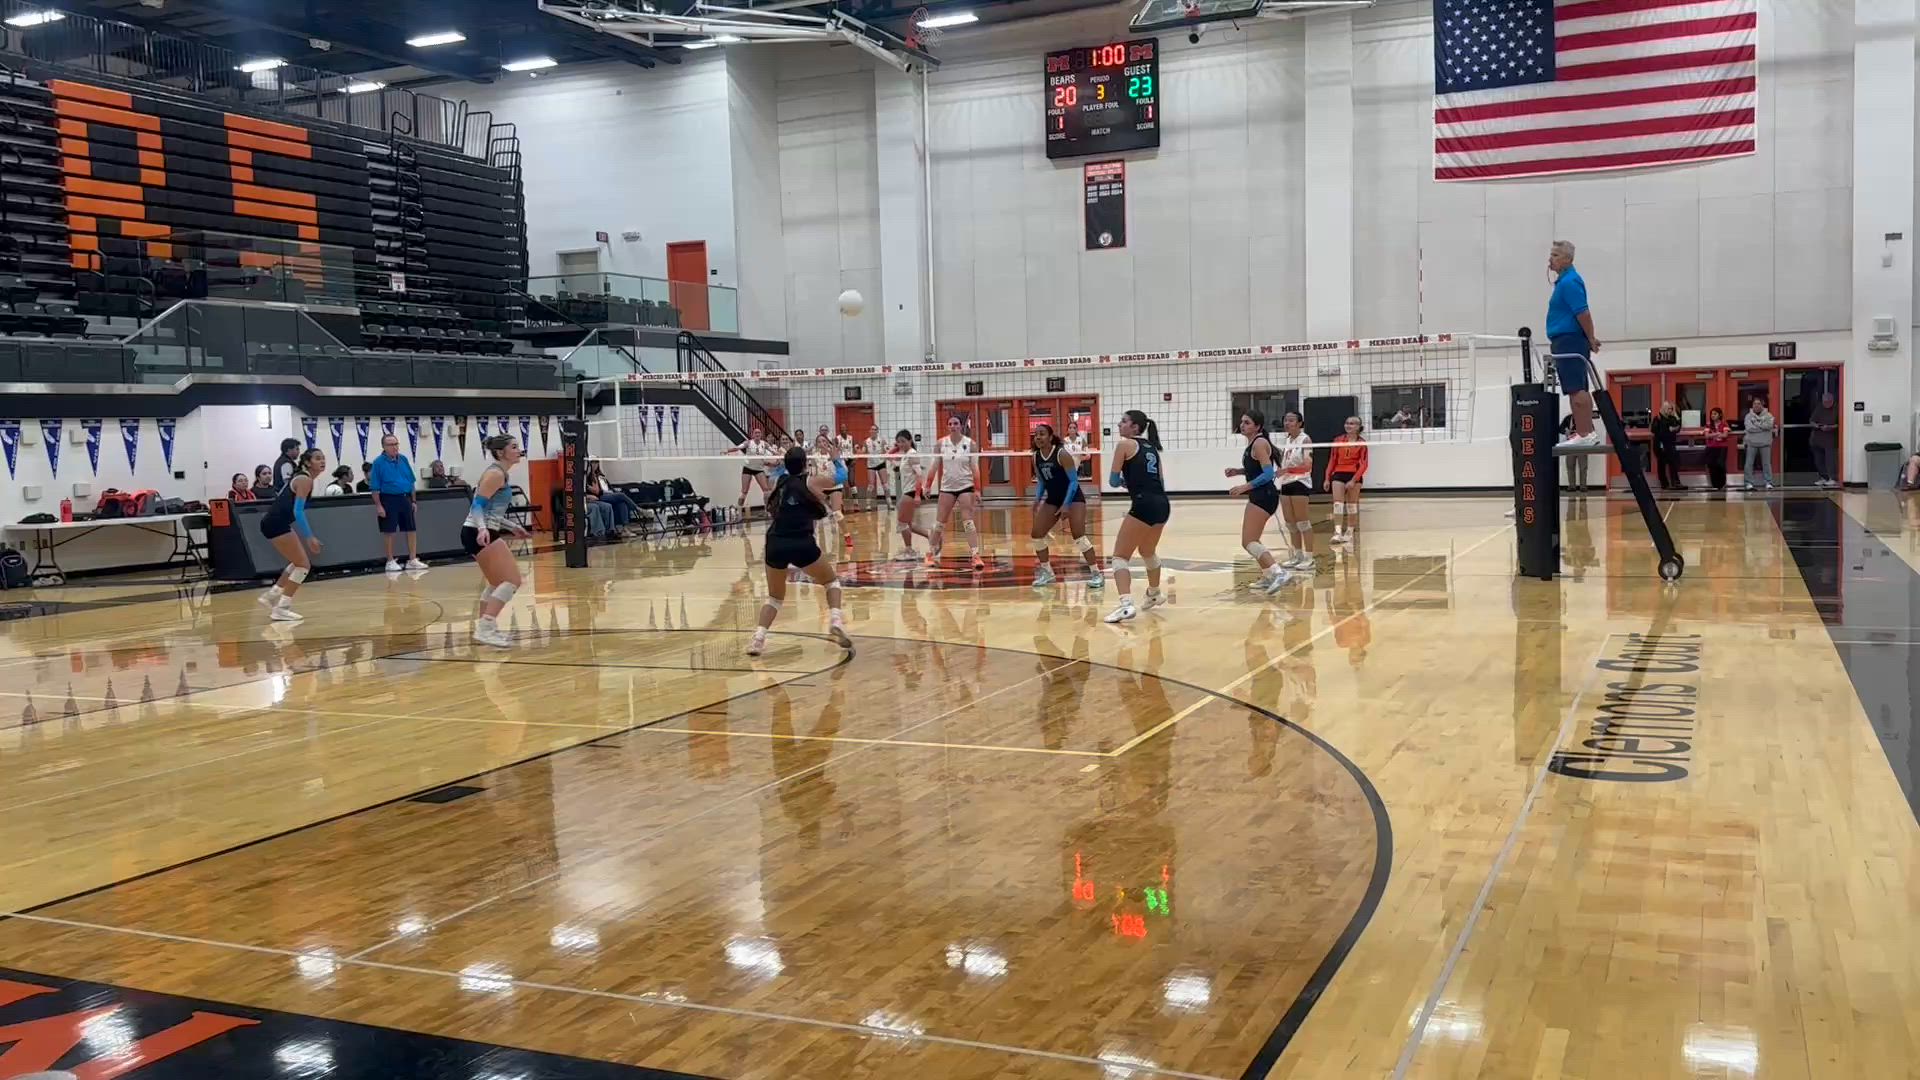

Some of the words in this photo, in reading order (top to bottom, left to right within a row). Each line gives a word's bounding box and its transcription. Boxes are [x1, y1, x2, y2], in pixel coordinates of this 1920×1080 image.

[1092, 44, 1125, 67] 1:00
[1129, 43, 1154, 61] M
[1047, 55, 1070, 73] M
[1124, 64, 1151, 76] GUEST
[1050, 74, 1076, 86] BEARS
[1090, 75, 1110, 84] PERIOD
[1128, 76, 1152, 97] 23
[1054, 86, 1077, 107] 20
[1096, 84, 1105, 100] 3
[1082, 103, 1103, 112] PLAYER
[1136, 97, 1154, 105] FOULS
[1148, 105, 1153, 119] 1
[1059, 116, 1064, 129] 1
[1136, 122, 1155, 130] SCORE
[1090, 128, 1111, 136] MATCH
[1178, 351, 1189, 359] M
[1260, 346, 1273, 354] M
[1347, 340, 1360, 349] M
[1369, 339, 1400, 347] MERCED
[1438, 334, 1452, 342] M
[1775, 347, 1792, 356] EXIT
[1656, 352, 1671, 361] EXIT
[1145, 452, 1158, 474] 2
[1521, 415, 1535, 523] BEARS
[1596, 632, 1702, 673] Court
[1547, 682, 1697, 783] Clemons
